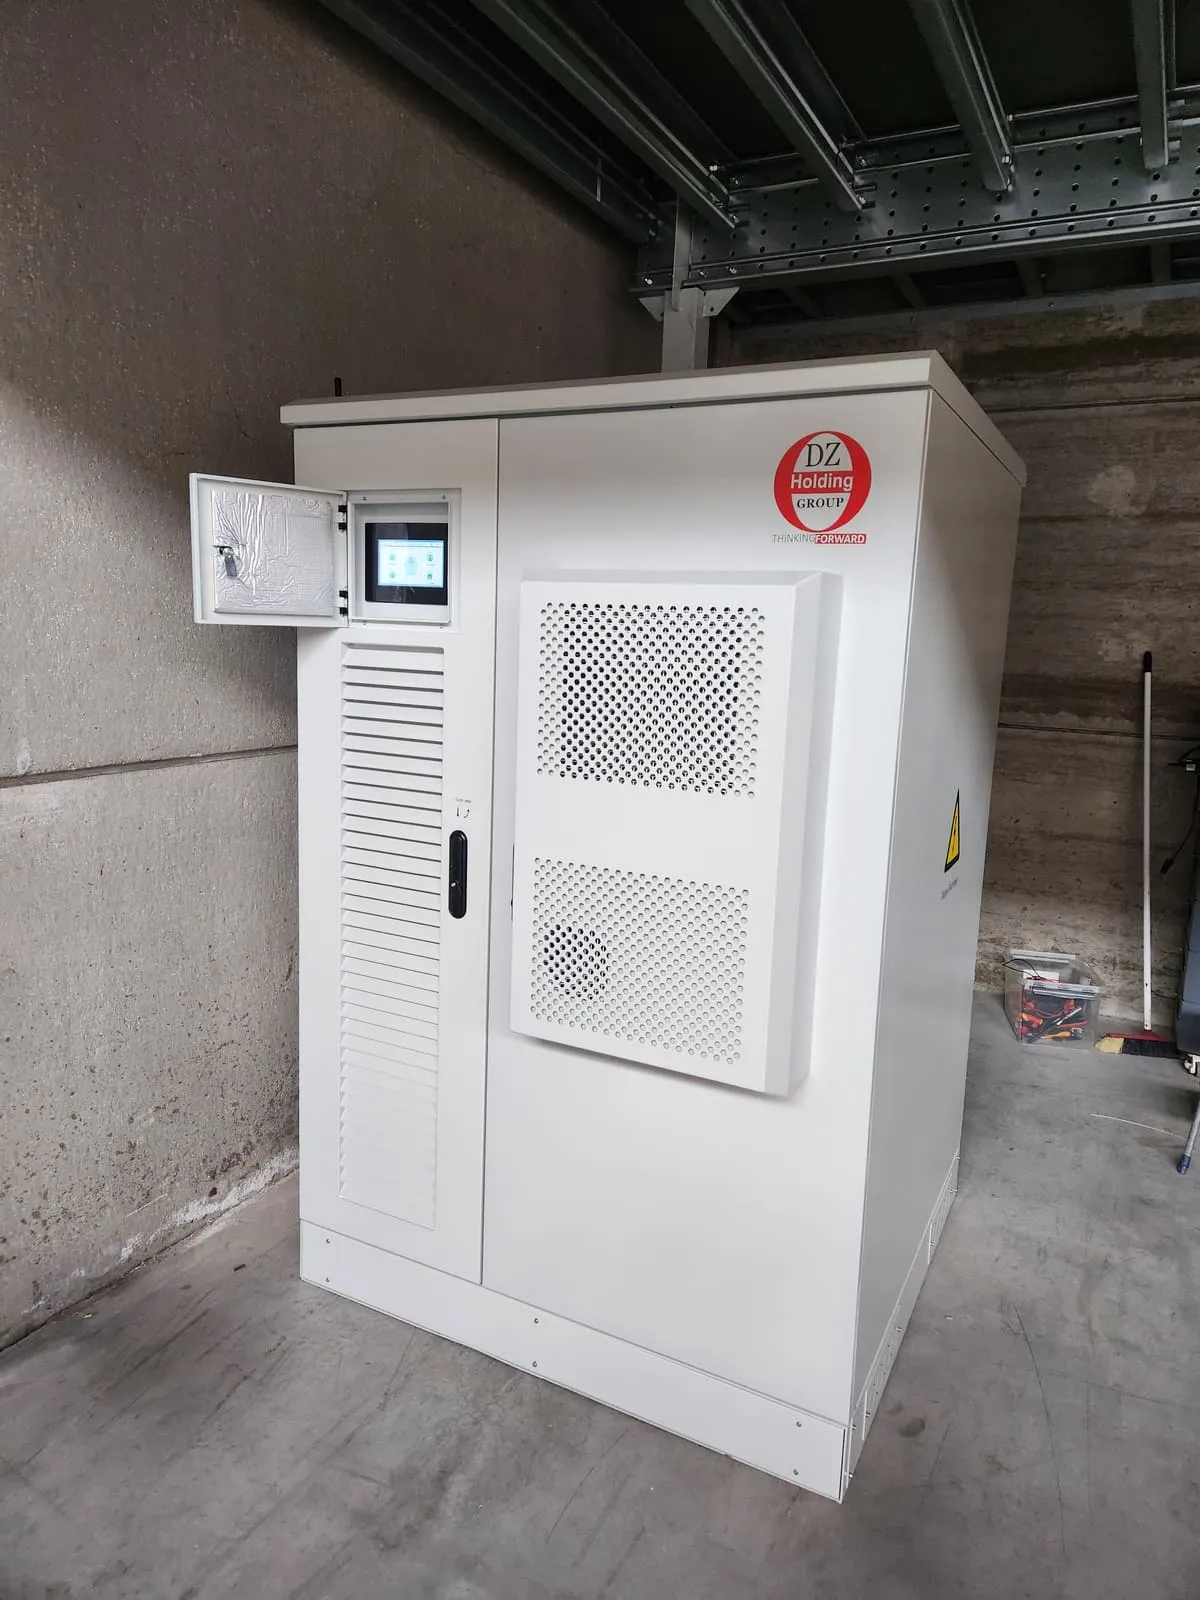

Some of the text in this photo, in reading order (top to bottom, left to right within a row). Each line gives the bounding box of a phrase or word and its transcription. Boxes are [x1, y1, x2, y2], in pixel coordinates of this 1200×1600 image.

[805, 442, 841, 467] DZ
[790, 473, 854, 491] Holding
[797, 497, 844, 508] GROUP
